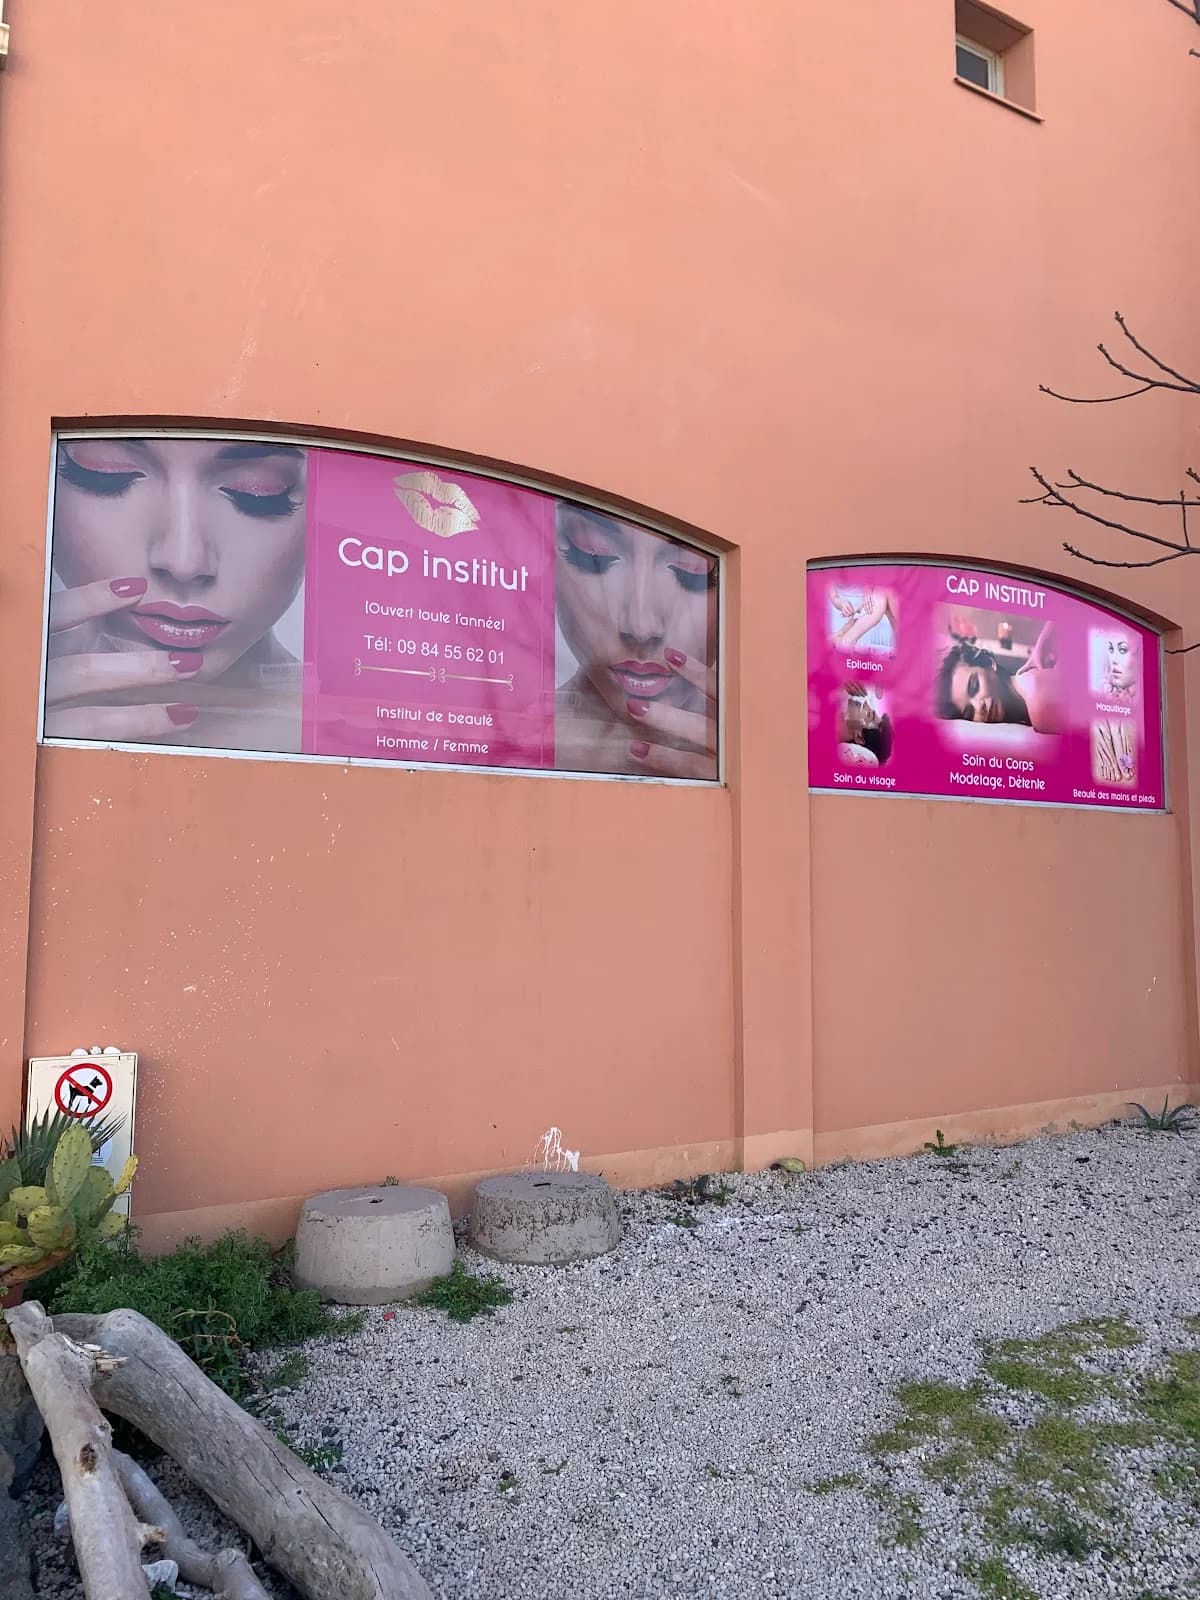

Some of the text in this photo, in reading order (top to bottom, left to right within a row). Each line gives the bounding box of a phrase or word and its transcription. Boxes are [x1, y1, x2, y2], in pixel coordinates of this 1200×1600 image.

[338, 537, 529, 592] Cap institut
[946, 575, 1046, 609] CAP INSTITUT
[418, 609, 450, 624] toute
[363, 635, 504, 665] Tél: 09 84 55 62 01
[846, 659, 883, 672] Epilation
[376, 705, 493, 727] Institut de beauté
[1096, 702, 1131, 716] Maquillage
[376, 735, 489, 754] Homme / Femme
[962, 753, 1034, 772] Soin du Corps
[833, 773, 896, 788] Soin du visage
[950, 771, 1046, 791] Modelage, Détente
[1073, 788, 1156, 804] Beauté des mains et pieds
